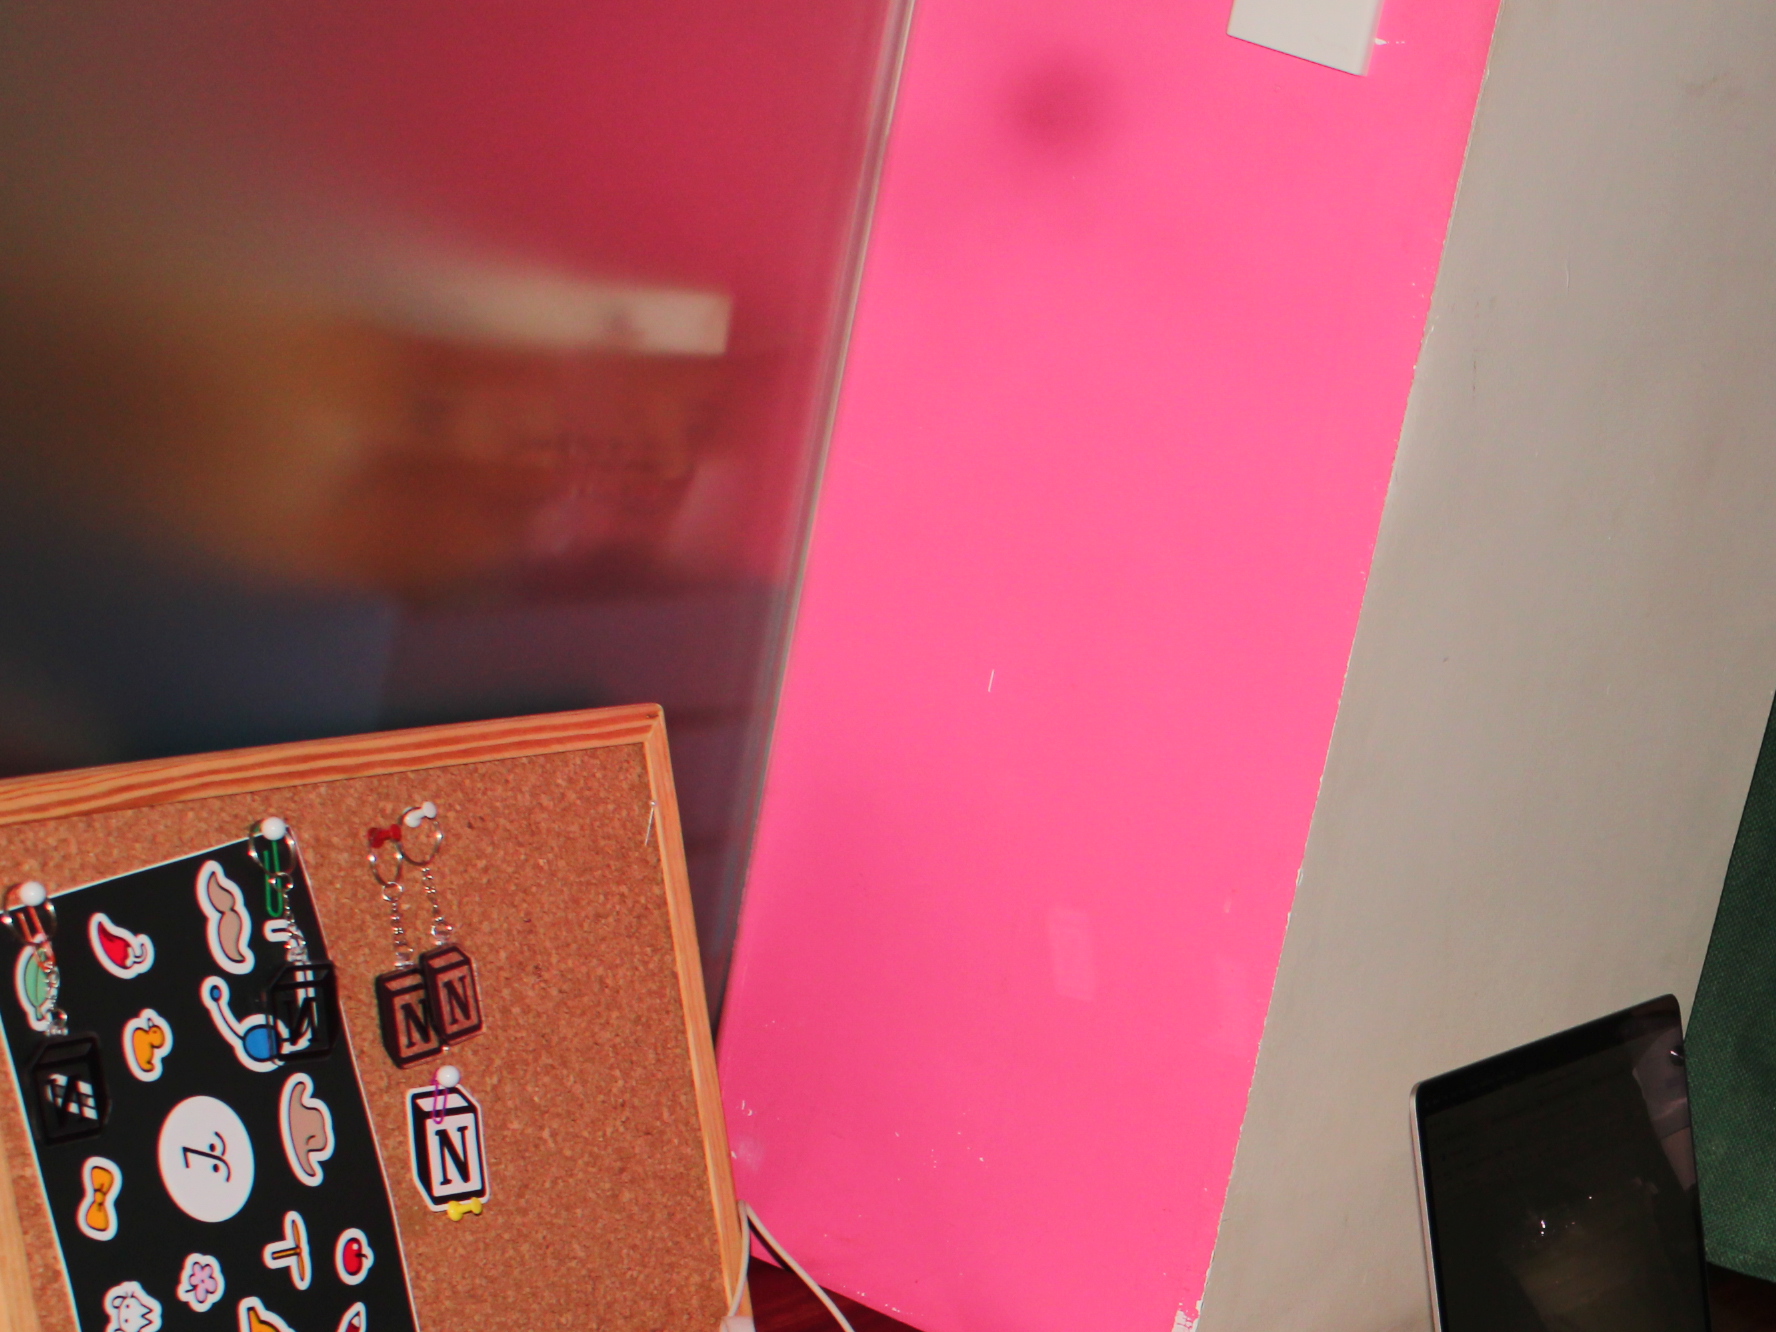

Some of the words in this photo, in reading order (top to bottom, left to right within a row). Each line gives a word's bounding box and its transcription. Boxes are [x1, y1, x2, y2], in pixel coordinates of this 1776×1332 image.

[400, 998, 432, 1049] N
[442, 975, 471, 1025] N
[434, 1126, 471, 1185] N
